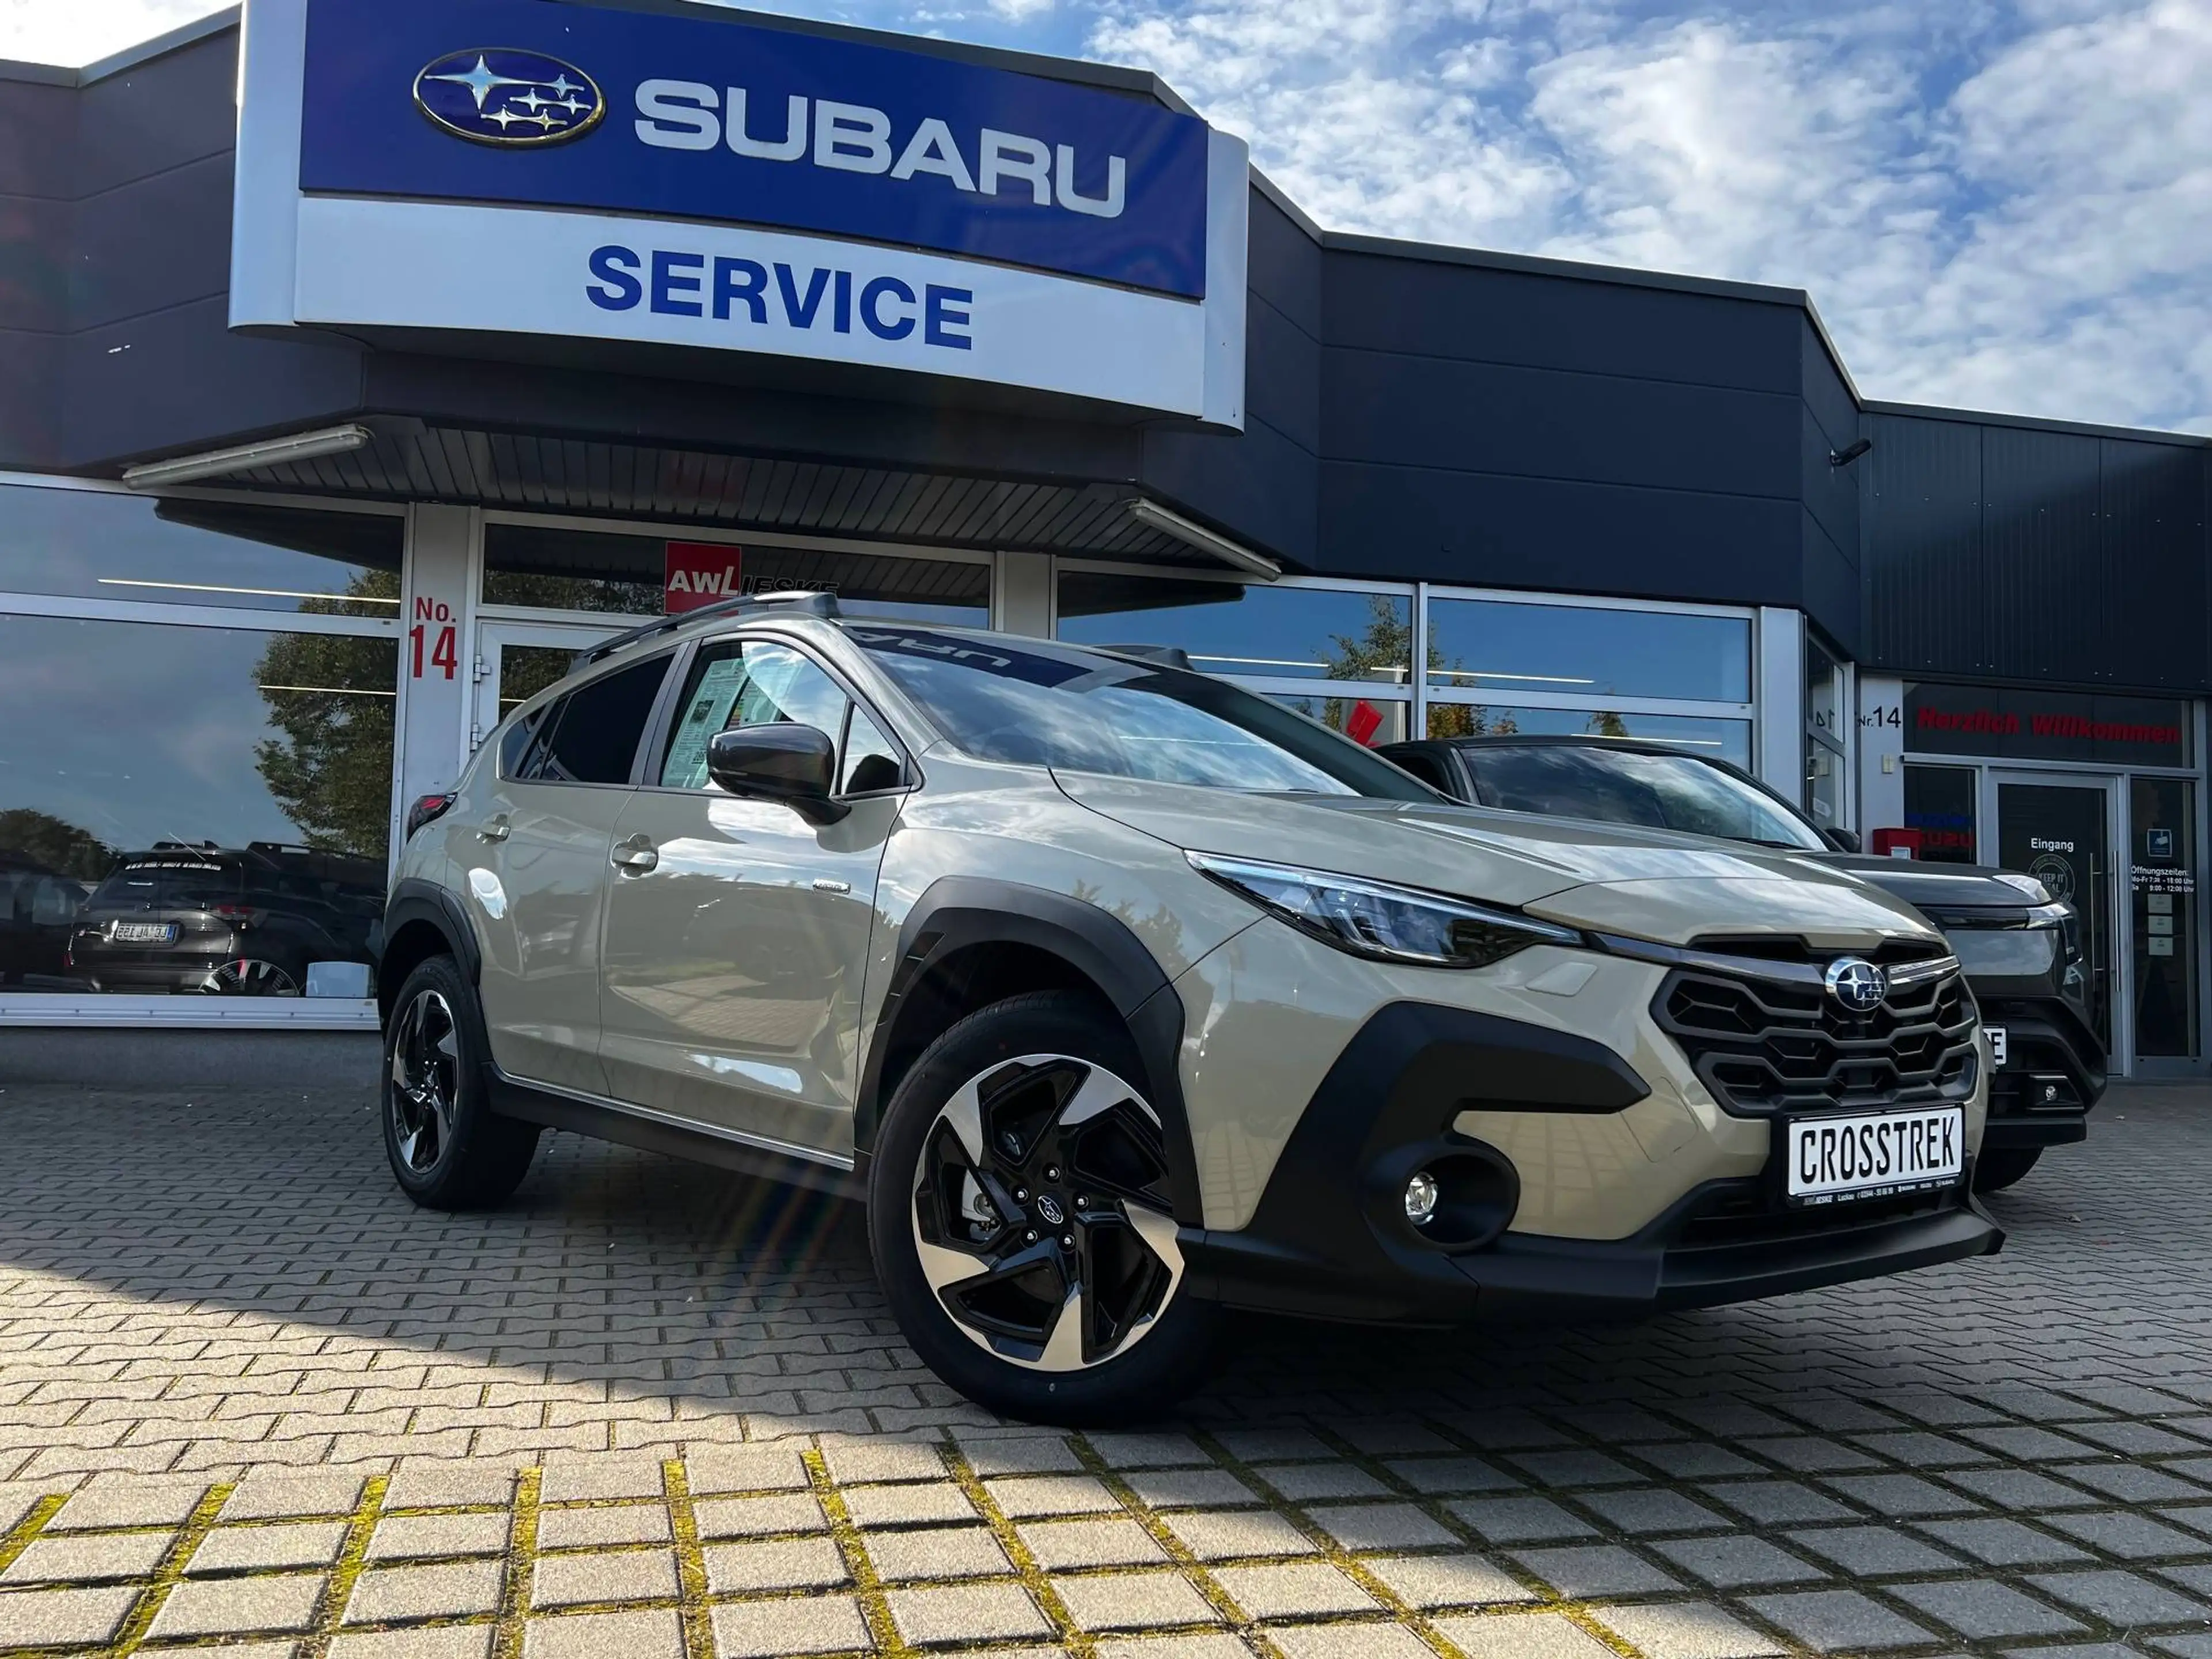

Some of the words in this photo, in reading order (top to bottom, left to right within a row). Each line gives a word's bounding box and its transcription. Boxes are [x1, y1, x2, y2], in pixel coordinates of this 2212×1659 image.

[634, 78, 1126, 218] SUBARU
[586, 245, 972, 350] SERVICE
[416, 597, 456, 622] No.
[410, 624, 457, 680] 14
[1918, 707, 2019, 734] Herzlich
[2032, 714, 2181, 743] Willkommen
[2031, 838, 2074, 852] Eingang
[1986, 1033, 2003, 1059] E
[1801, 1116, 1955, 1184] CROSSTREK
